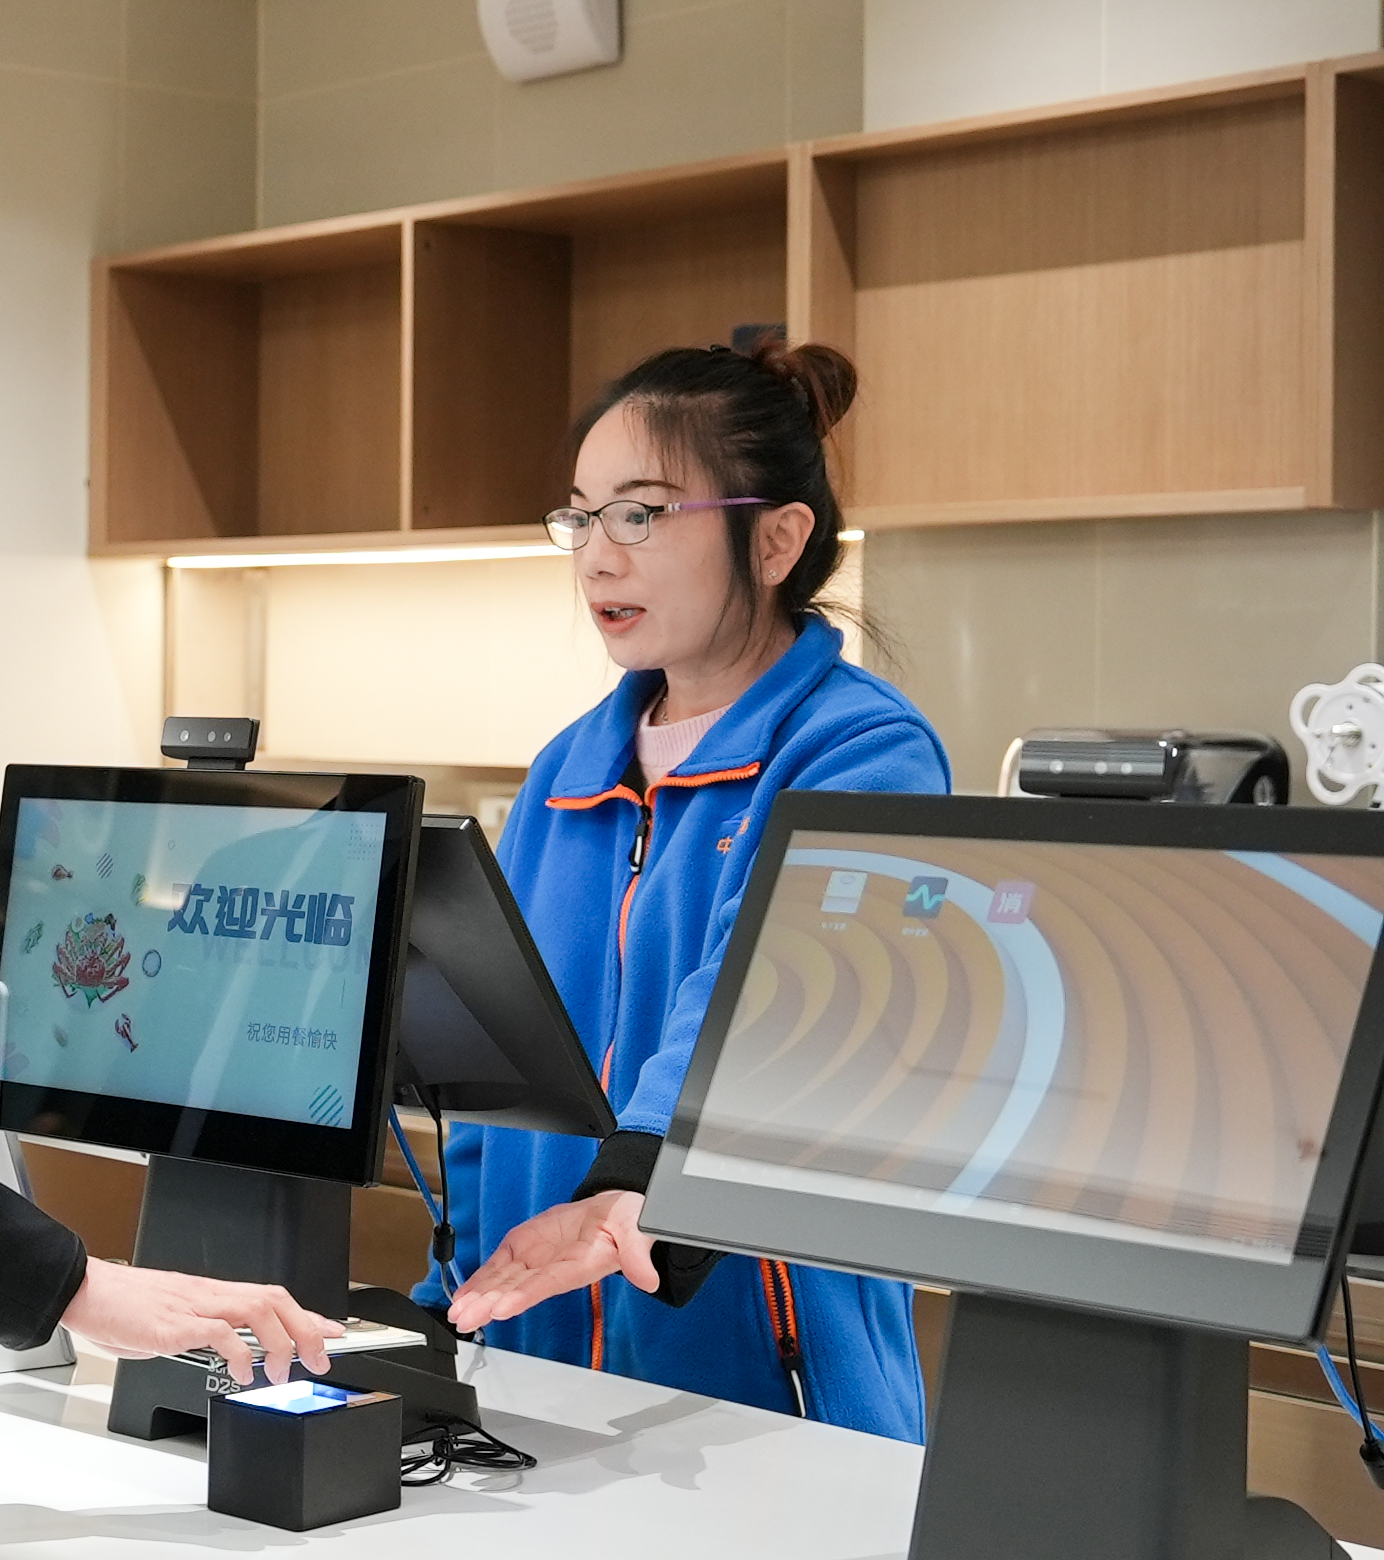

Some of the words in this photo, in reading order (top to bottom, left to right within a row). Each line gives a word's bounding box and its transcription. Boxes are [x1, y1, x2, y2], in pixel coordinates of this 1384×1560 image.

[167, 883, 355, 947] 欢迎光临
[246, 1022, 337, 1050] 祝您用餐愉快
